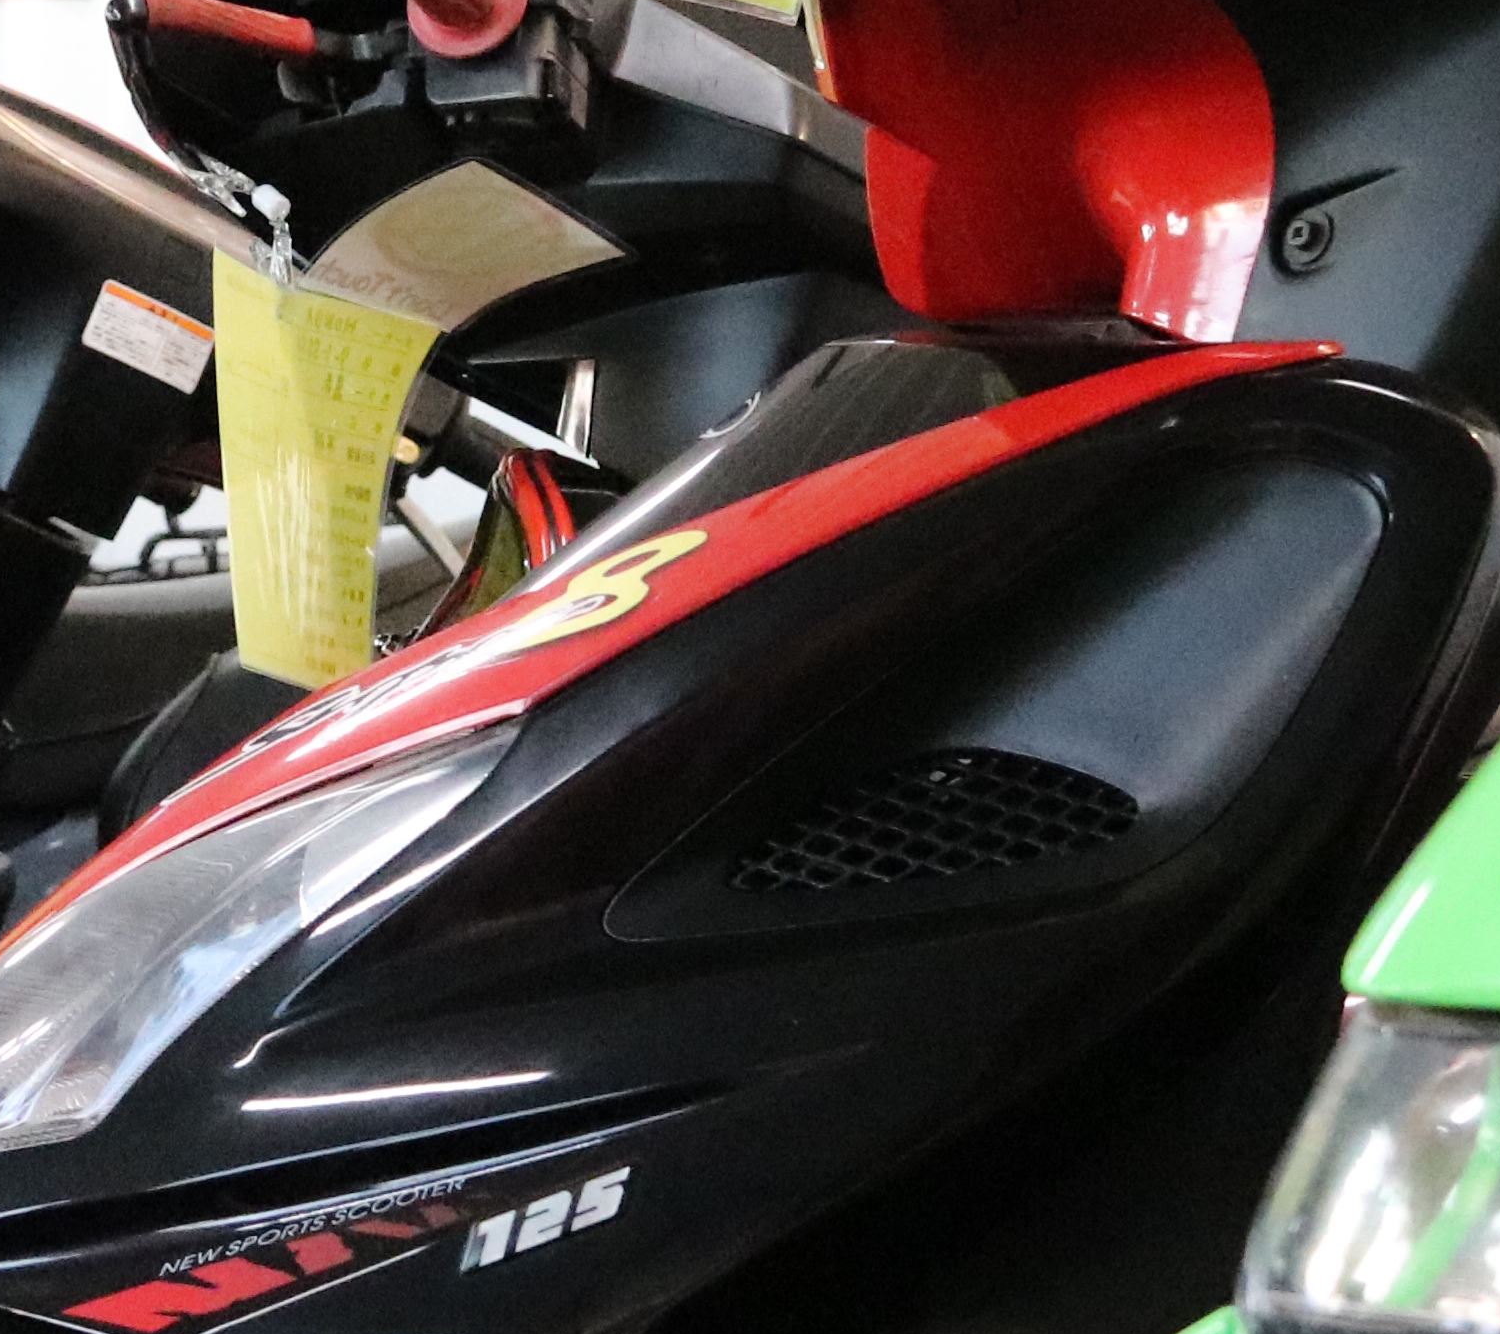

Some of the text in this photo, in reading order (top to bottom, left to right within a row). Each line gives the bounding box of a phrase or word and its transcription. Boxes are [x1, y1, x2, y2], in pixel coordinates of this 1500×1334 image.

[160, 1177, 467, 1277] NEW SPORTS SCOOTER
[461, 1166, 631, 1274] 125
